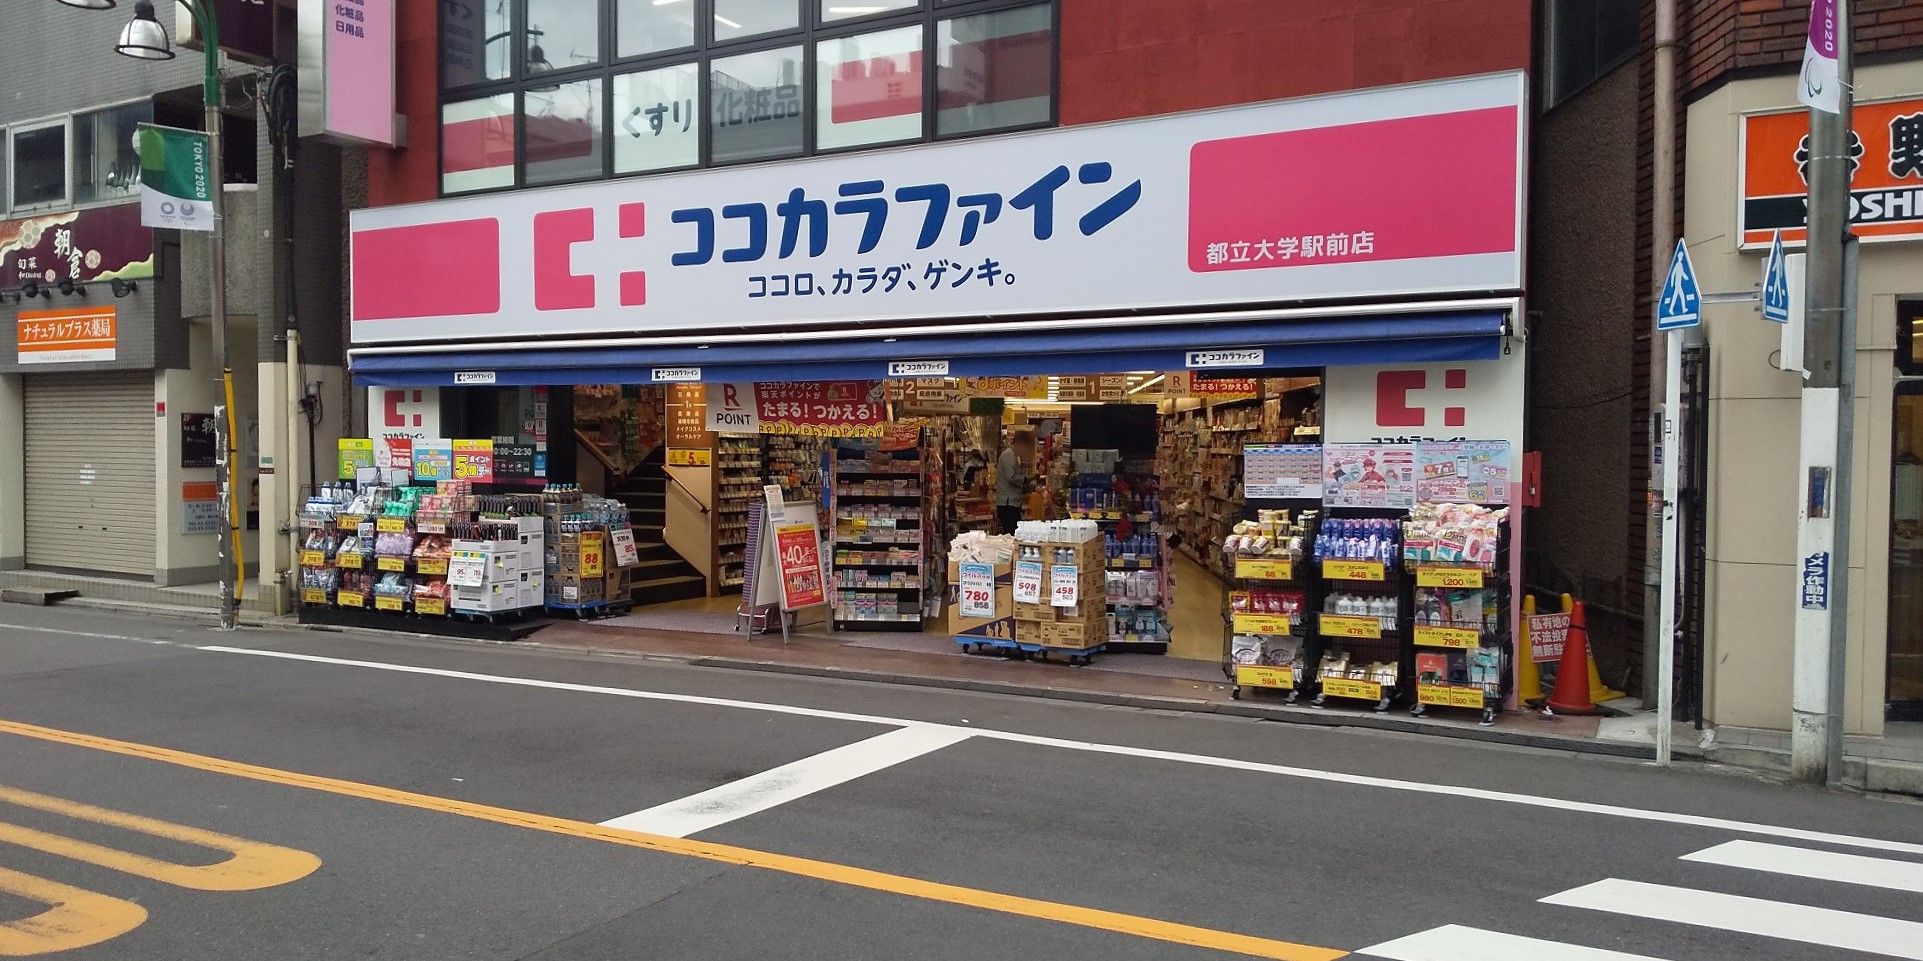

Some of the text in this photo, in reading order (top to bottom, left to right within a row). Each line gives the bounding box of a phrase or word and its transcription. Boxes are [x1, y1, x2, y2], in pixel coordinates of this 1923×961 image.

[335, 4, 364, 22] 化粧品
[336, 20, 364, 38] 日用品
[1825, 6, 1833, 51] 2020
[716, 83, 800, 128] 化粧品
[621, 98, 692, 138] くすり
[194, 142, 206, 198] TOKYO 2020
[671, 161, 1142, 266] ココカラファイン
[1206, 230, 1375, 265] 都立大学駅前店
[747, 257, 1015, 298] ココロ、カラダ、ゲンキ。
[23, 317, 110, 340] ナチュラルプラス薬局
[1208, 352, 1260, 360] ココカラファイン
[723, 384, 740, 407] R
[905, 381, 915, 394] 2
[1089, 381, 1095, 394] 1
[716, 413, 751, 425] POINT
[624, 544, 634, 552] 85
[584, 553, 598, 564] 88
[1018, 582, 1036, 590] 598
[965, 590, 989, 601] 780
